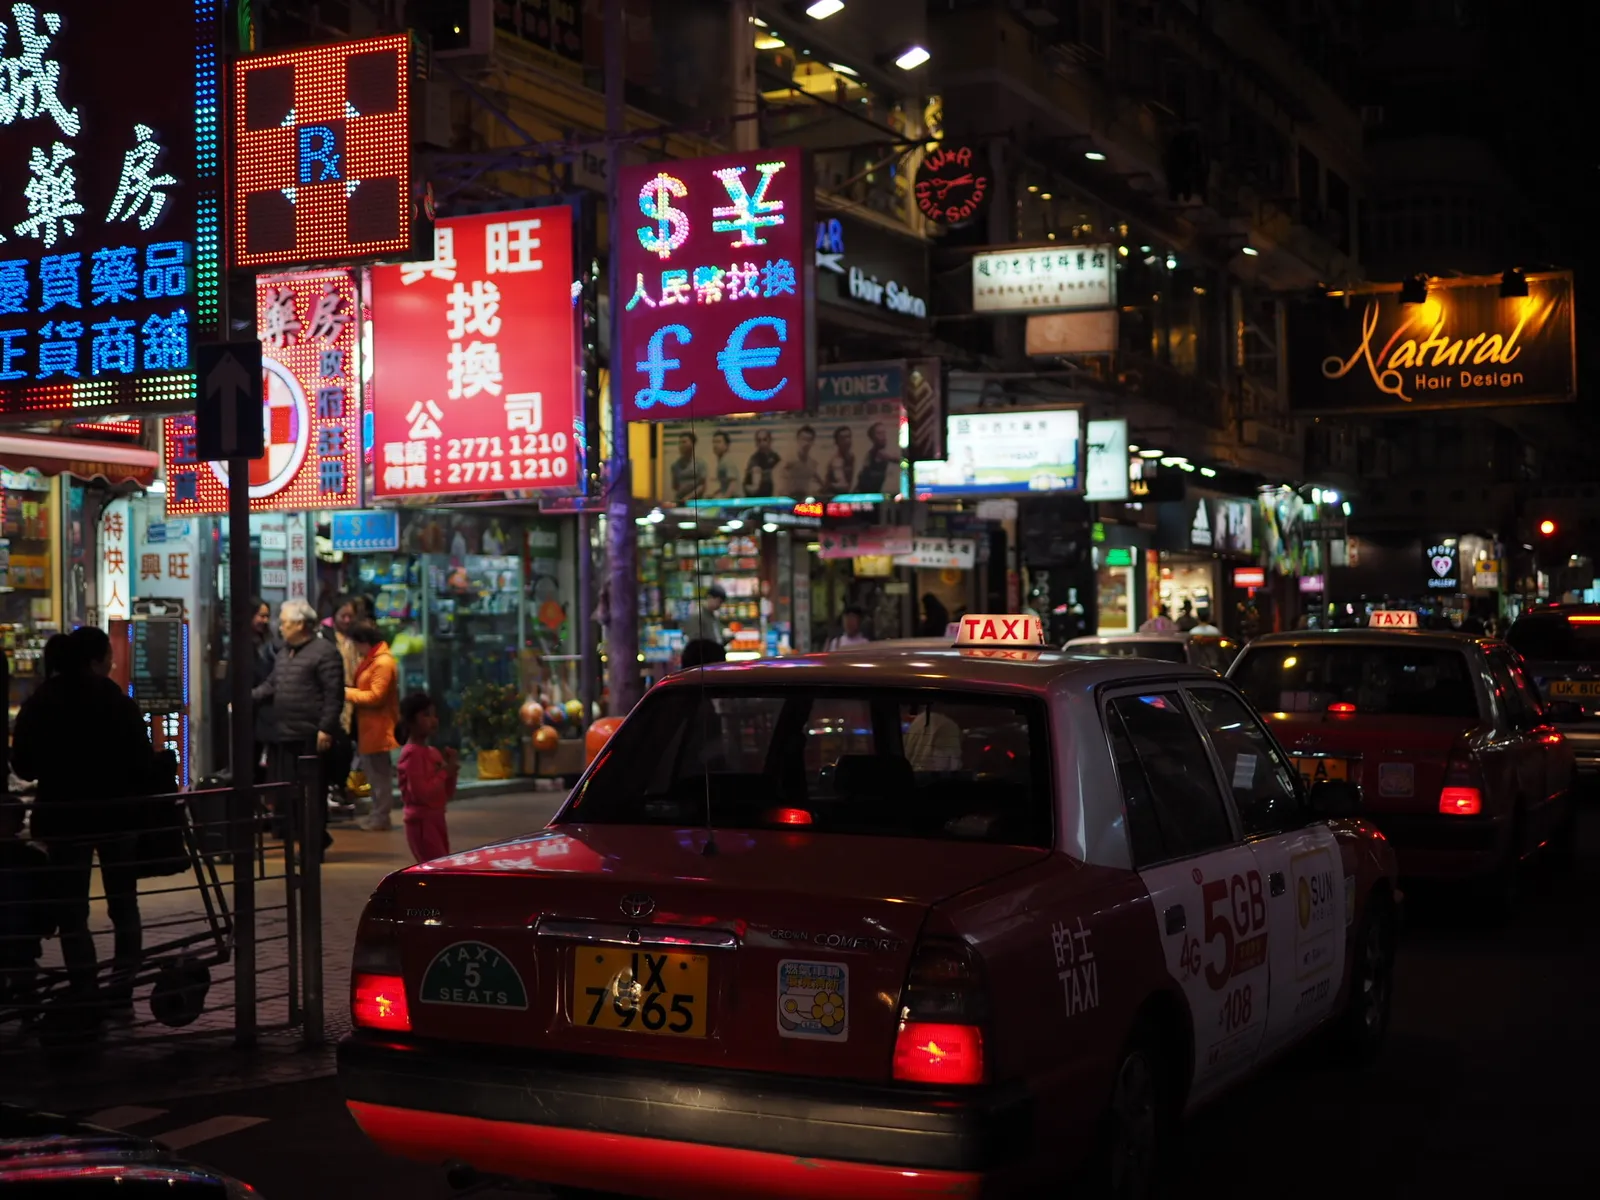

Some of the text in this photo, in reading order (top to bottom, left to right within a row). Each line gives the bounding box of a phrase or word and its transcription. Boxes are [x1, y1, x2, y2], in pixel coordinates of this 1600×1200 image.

[945, 176, 987, 223] Salon
[0, 241, 187, 314] 優質藥品
[625, 258, 796, 312] 人民幣找換
[849, 266, 884, 305] Hair
[257, 282, 355, 347] 藥房
[446, 280, 504, 399] 找換
[1321, 300, 1529, 402] Natural
[830, 373, 889, 396] YONEX
[1415, 370, 1524, 390] Hair Design
[405, 392, 543, 440] 公司
[447, 436, 503, 460] 2771
[508, 431, 567, 456] 1210
[447, 460, 504, 484] 2771
[509, 456, 568, 481] 1210
[103, 512, 125, 620] 特快人
[140, 552, 191, 580] 興旺
[965, 619, 1029, 640] TAXI
[1374, 613, 1412, 625] TAXI
[1556, 683, 1572, 694] UK
[1310, 874, 1333, 907] SUN
[405, 908, 441, 917] TOYOTA
[439, 946, 501, 968] TAXI
[770, 929, 904, 952] CROWN COMFORT
[1051, 916, 1094, 967] 的士
[1181, 934, 1201, 977] 4G
[464, 962, 481, 988] 5
[1058, 960, 1099, 1017] TAXI
[440, 987, 508, 1005] SEATS
[586, 986, 694, 1033] 7965
[1218, 984, 1252, 1032] $108
